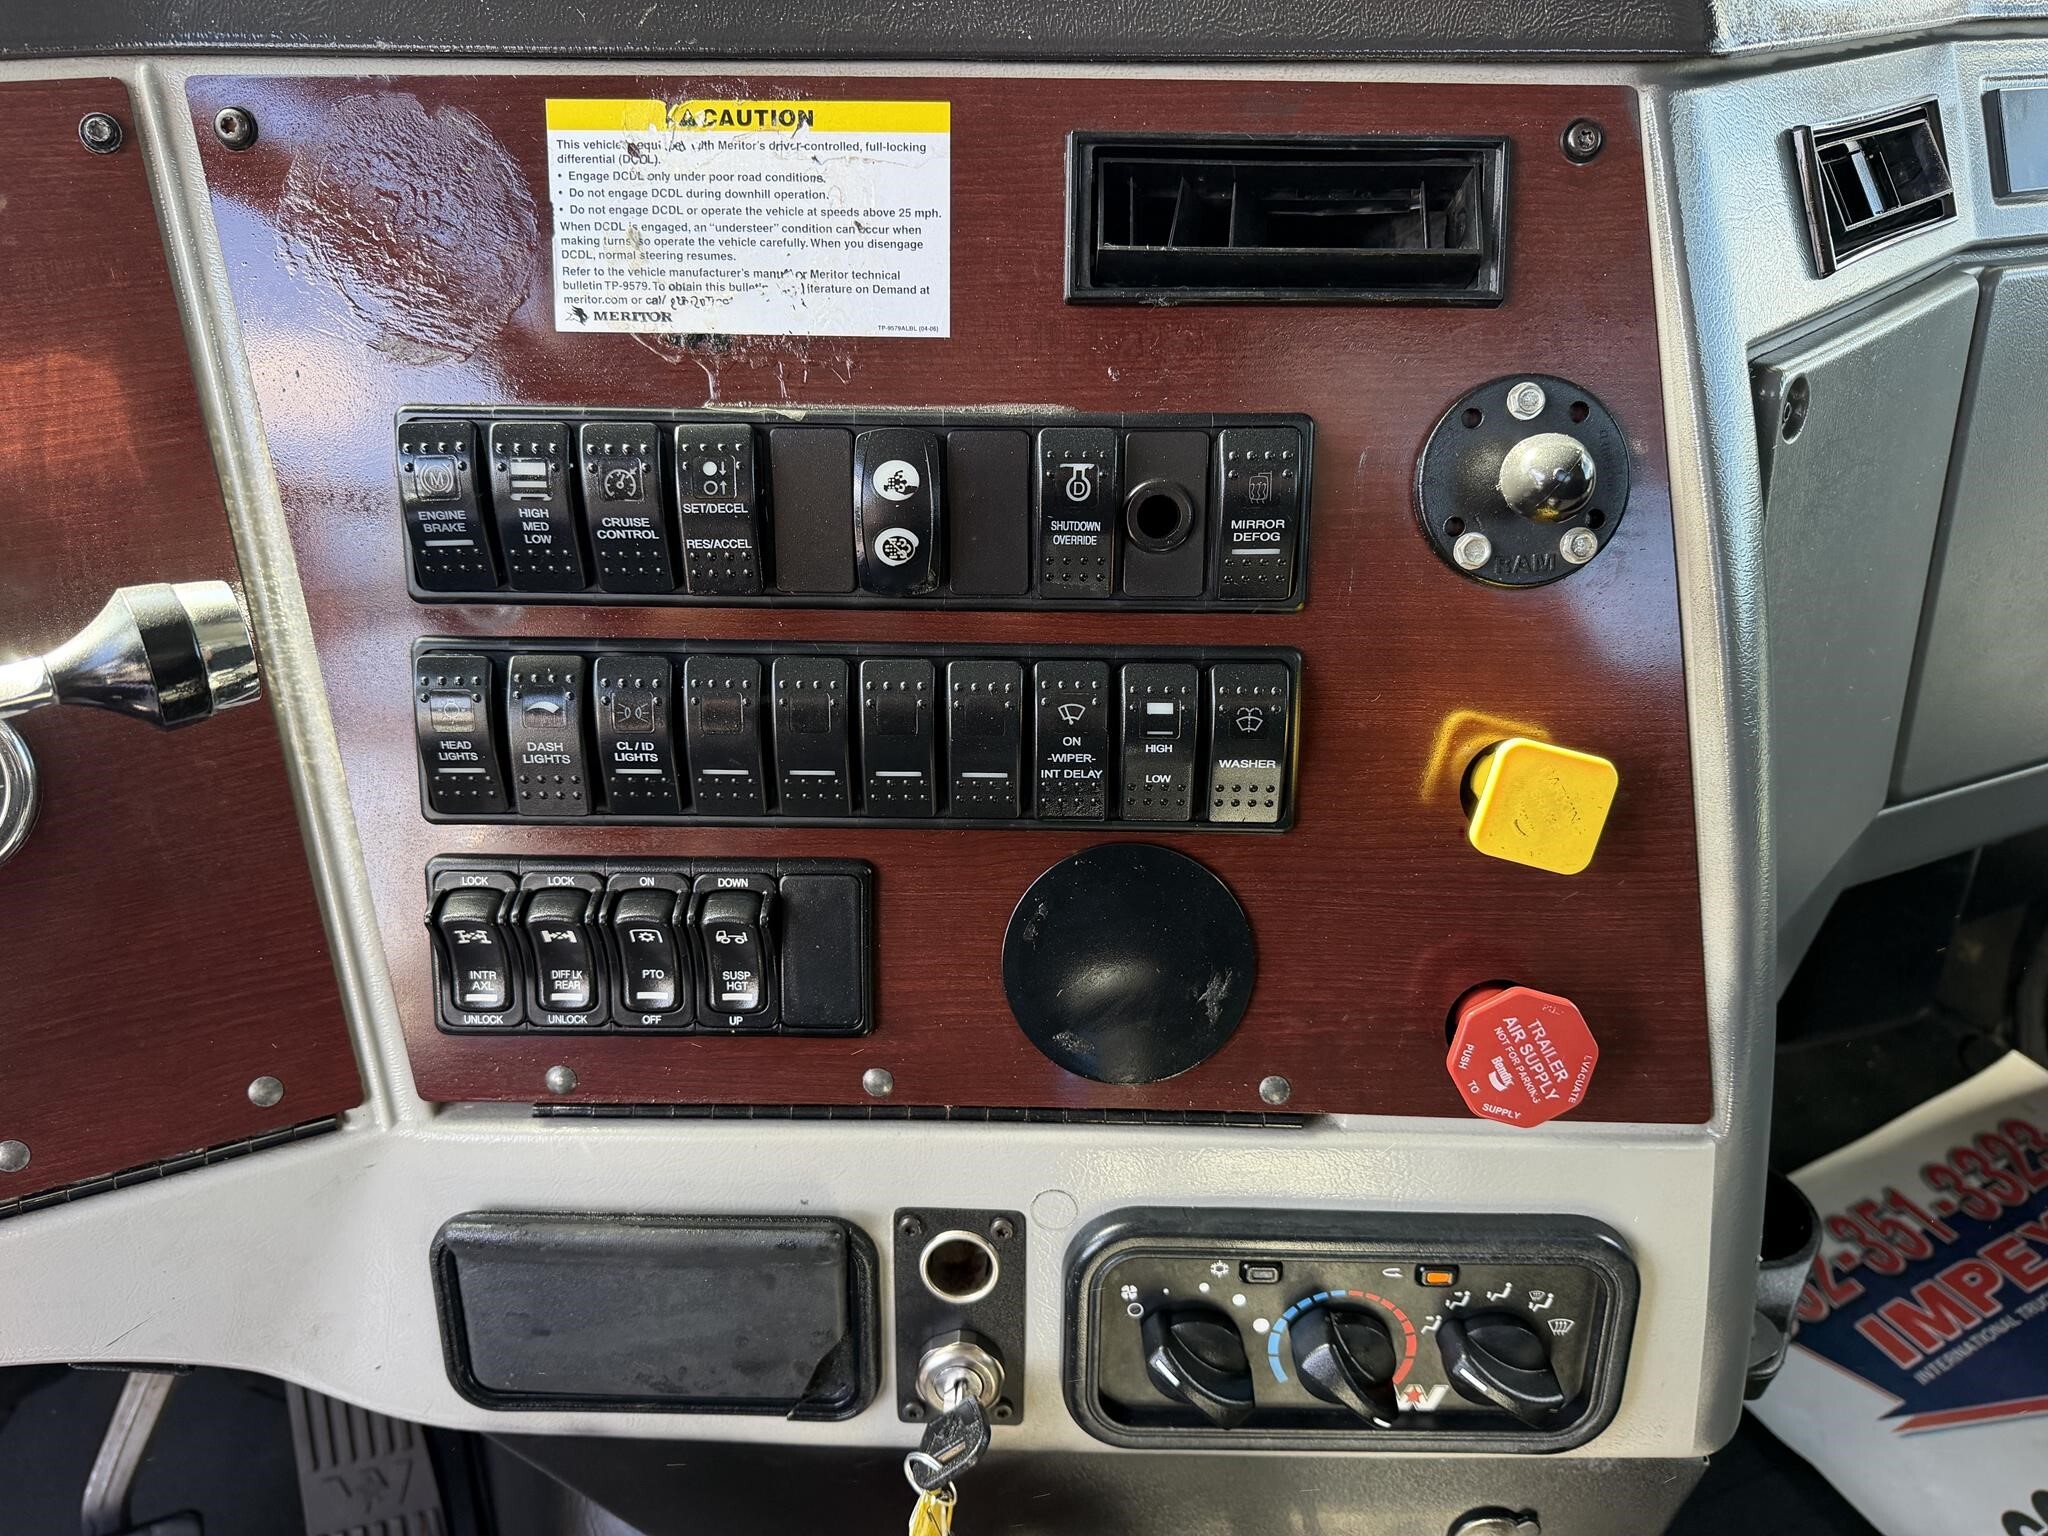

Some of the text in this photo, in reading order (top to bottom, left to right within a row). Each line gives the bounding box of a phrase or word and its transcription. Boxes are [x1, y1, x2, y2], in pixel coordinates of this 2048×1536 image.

[703, 108, 814, 127] CAUTION
[557, 139, 580, 150] This
[583, 139, 624, 150] vehicle
[718, 140, 766, 151] Meritor's
[769, 141, 863, 153] driver-controlled,
[865, 142, 927, 154] full-locking
[557, 154, 616, 164] differential
[568, 171, 609, 183] Engage
[647, 172, 670, 184] only
[674, 172, 706, 182] under
[709, 174, 734, 185] poor
[737, 173, 762, 183] road
[765, 173, 826, 184] conditions.
[569, 188, 829, 201] Do not engage DCDL during downhill operation.
[570, 205, 942, 220] Do not engage DCDL or operate the vehicle at speeds above 25 mph.
[560, 222, 591, 231] When
[594, 222, 625, 232] DCDL
[628, 222, 638, 232] is
[641, 223, 691, 234] engaged,
[782, 224, 832, 233] condition
[836, 226, 856, 234] can
[893, 225, 922, 235] when
[561, 237, 600, 247] making
[638, 238, 651, 246] so
[654, 238, 695, 248] operate
[698, 237, 715, 246] the
[718, 238, 757, 247] vehicle
[759, 238, 809, 250] carefully.
[811, 239, 841, 248] When
[844, 241, 864, 250] you
[867, 239, 924, 251] disengage
[561, 250, 737, 262] DCDL, normal steering resumes.
[562, 266, 590, 276] Refer
[594, 267, 605, 276] to
[607, 267, 625, 276] the
[628, 267, 666, 277] vehicle
[668, 268, 750, 278] manufacturer's
[810, 269, 849, 279] Meritor
[851, 270, 901, 280] technical
[562, 281, 603, 290] bulletin
[604, 281, 651, 291] TP-9579.
[654, 282, 665, 291] To
[668, 282, 702, 291] obtain
[705, 282, 725, 291] this
[855, 286, 870, 294] on
[872, 285, 917, 294] Demand
[919, 285, 930, 294] at
[563, 295, 628, 304] meritor.com
[593, 311, 673, 323] MERITOR
[519, 508, 549, 519] HIGH
[682, 503, 749, 514] SET/DECEL
[418, 510, 467, 521] ENGINE
[423, 522, 466, 533] BRAKE
[523, 521, 549, 531] MED
[602, 517, 650, 528] CRUISE
[1051, 520, 1101, 532] SHUTDOWN
[1231, 519, 1286, 530] MIRROR
[524, 534, 552, 545] LOW
[597, 529, 660, 540] CONTROL
[1053, 534, 1097, 546] OVERRIDE
[1233, 531, 1281, 542] DEFOG
[686, 538, 752, 549] RES/ACCEL
[440, 740, 472, 750] HEAD
[527, 742, 563, 752] DASH
[1062, 737, 1082, 747] ON
[1145, 744, 1173, 754] HIGH
[438, 751, 479, 761] LIGHTS
[522, 754, 571, 765] LIGHTS
[614, 752, 659, 763] LIGHTS
[1047, 753, 1096, 764] -WIPER-
[1219, 759, 1276, 769] WASHER
[1041, 768, 1103, 780] INT DELAY
[1145, 774, 1171, 784] LOW
[462, 876, 489, 886] LOCK
[548, 876, 575, 886] LOCK
[639, 877, 655, 886] ON
[718, 878, 749, 888] DOWN
[470, 971, 497, 980] INTR
[551, 971, 583, 980] DIFF LK
[642, 969, 664, 979] PTO
[722, 971, 751, 981] SUSP
[472, 981, 495, 991] AXL
[555, 980, 581, 991] REAR
[726, 982, 748, 991] HGT
[463, 1015, 504, 1025] UNLOCK
[548, 1015, 588, 1025] UNLOCK
[642, 1015, 662, 1025] OFF
[729, 1016, 743, 1026] UP
[1528, 1018, 1568, 1083] TRAILER
[1502, 1016, 1526, 1043] AIR
[1520, 1043, 1560, 1100] SUPPLY
[1494, 1026, 1541, 1104] NOT FOR PARKING
[1491, 1055, 1515, 1087] Bendix
[1459, 1043, 1521, 1119] PUSH TO SUPPLY
